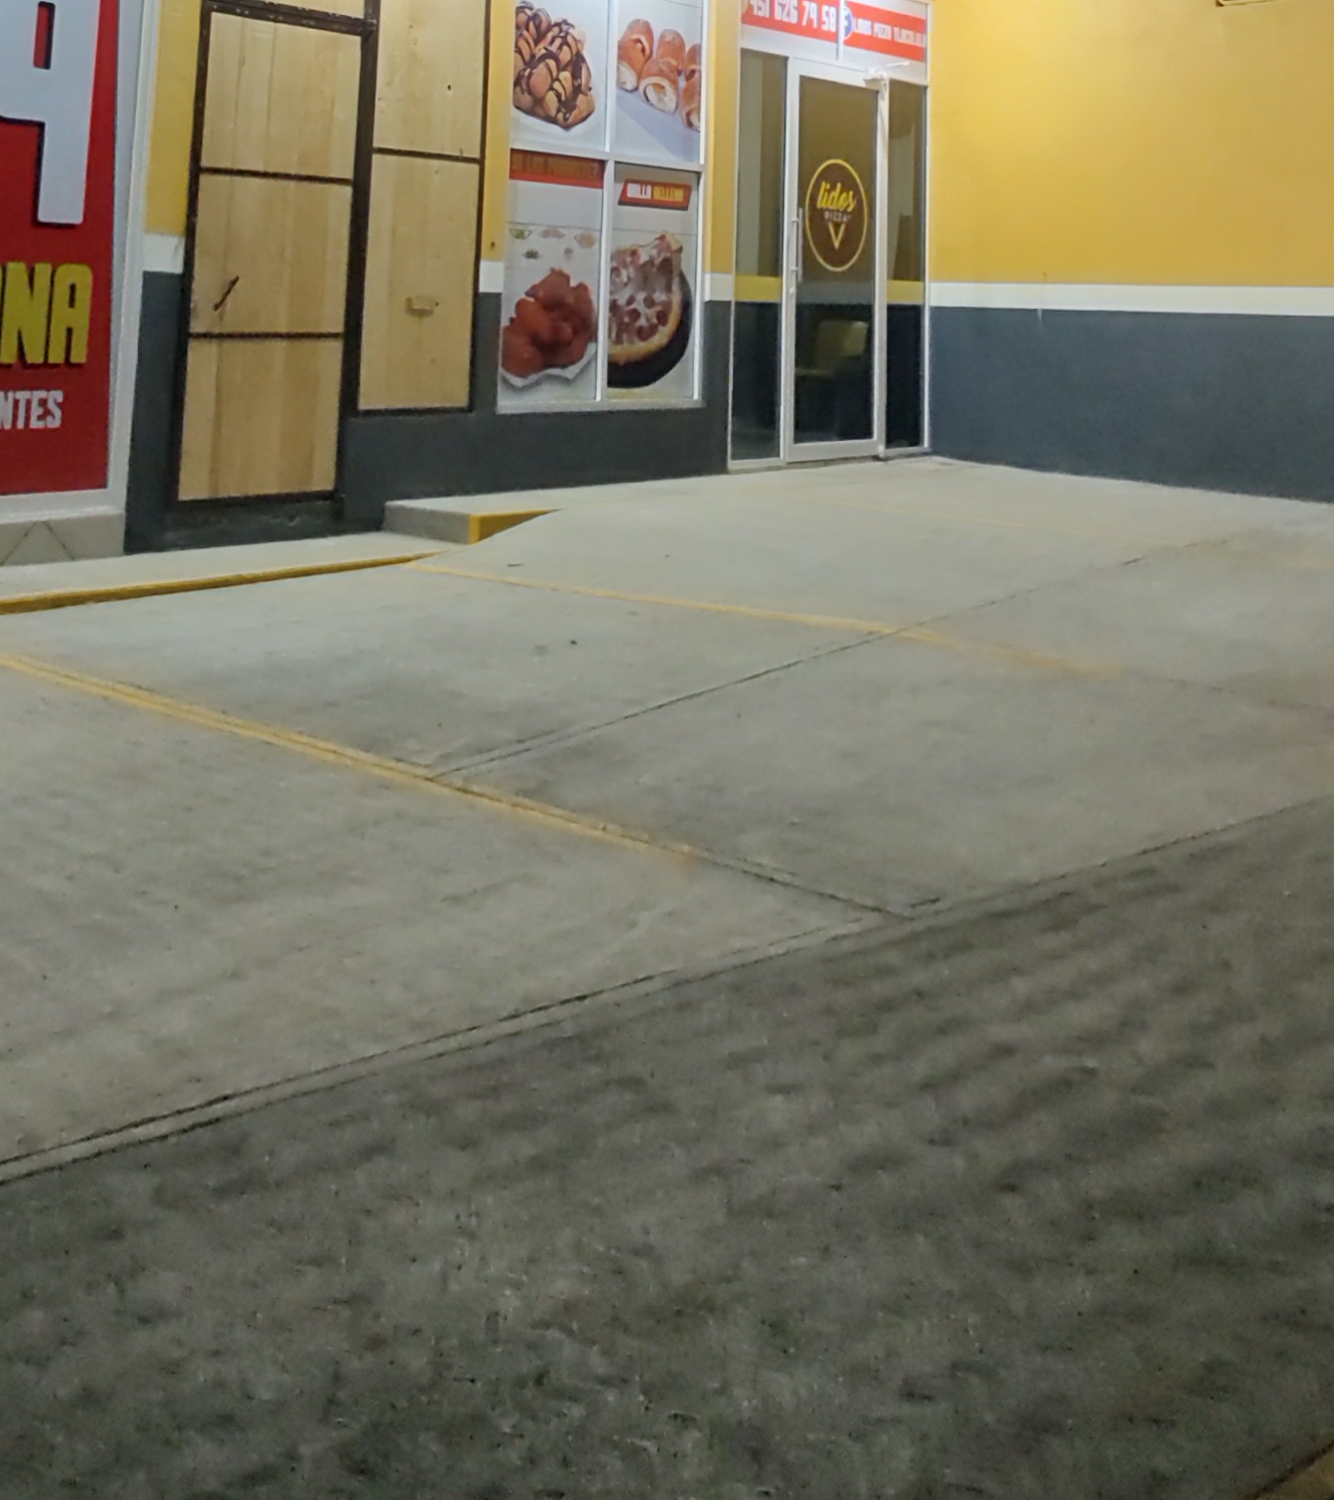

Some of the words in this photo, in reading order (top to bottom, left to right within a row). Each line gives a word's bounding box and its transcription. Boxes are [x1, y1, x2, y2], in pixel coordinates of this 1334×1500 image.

[802, 0, 818, 28] 79
[822, 5, 837, 32] 58
[817, 181, 856, 211] lidos
